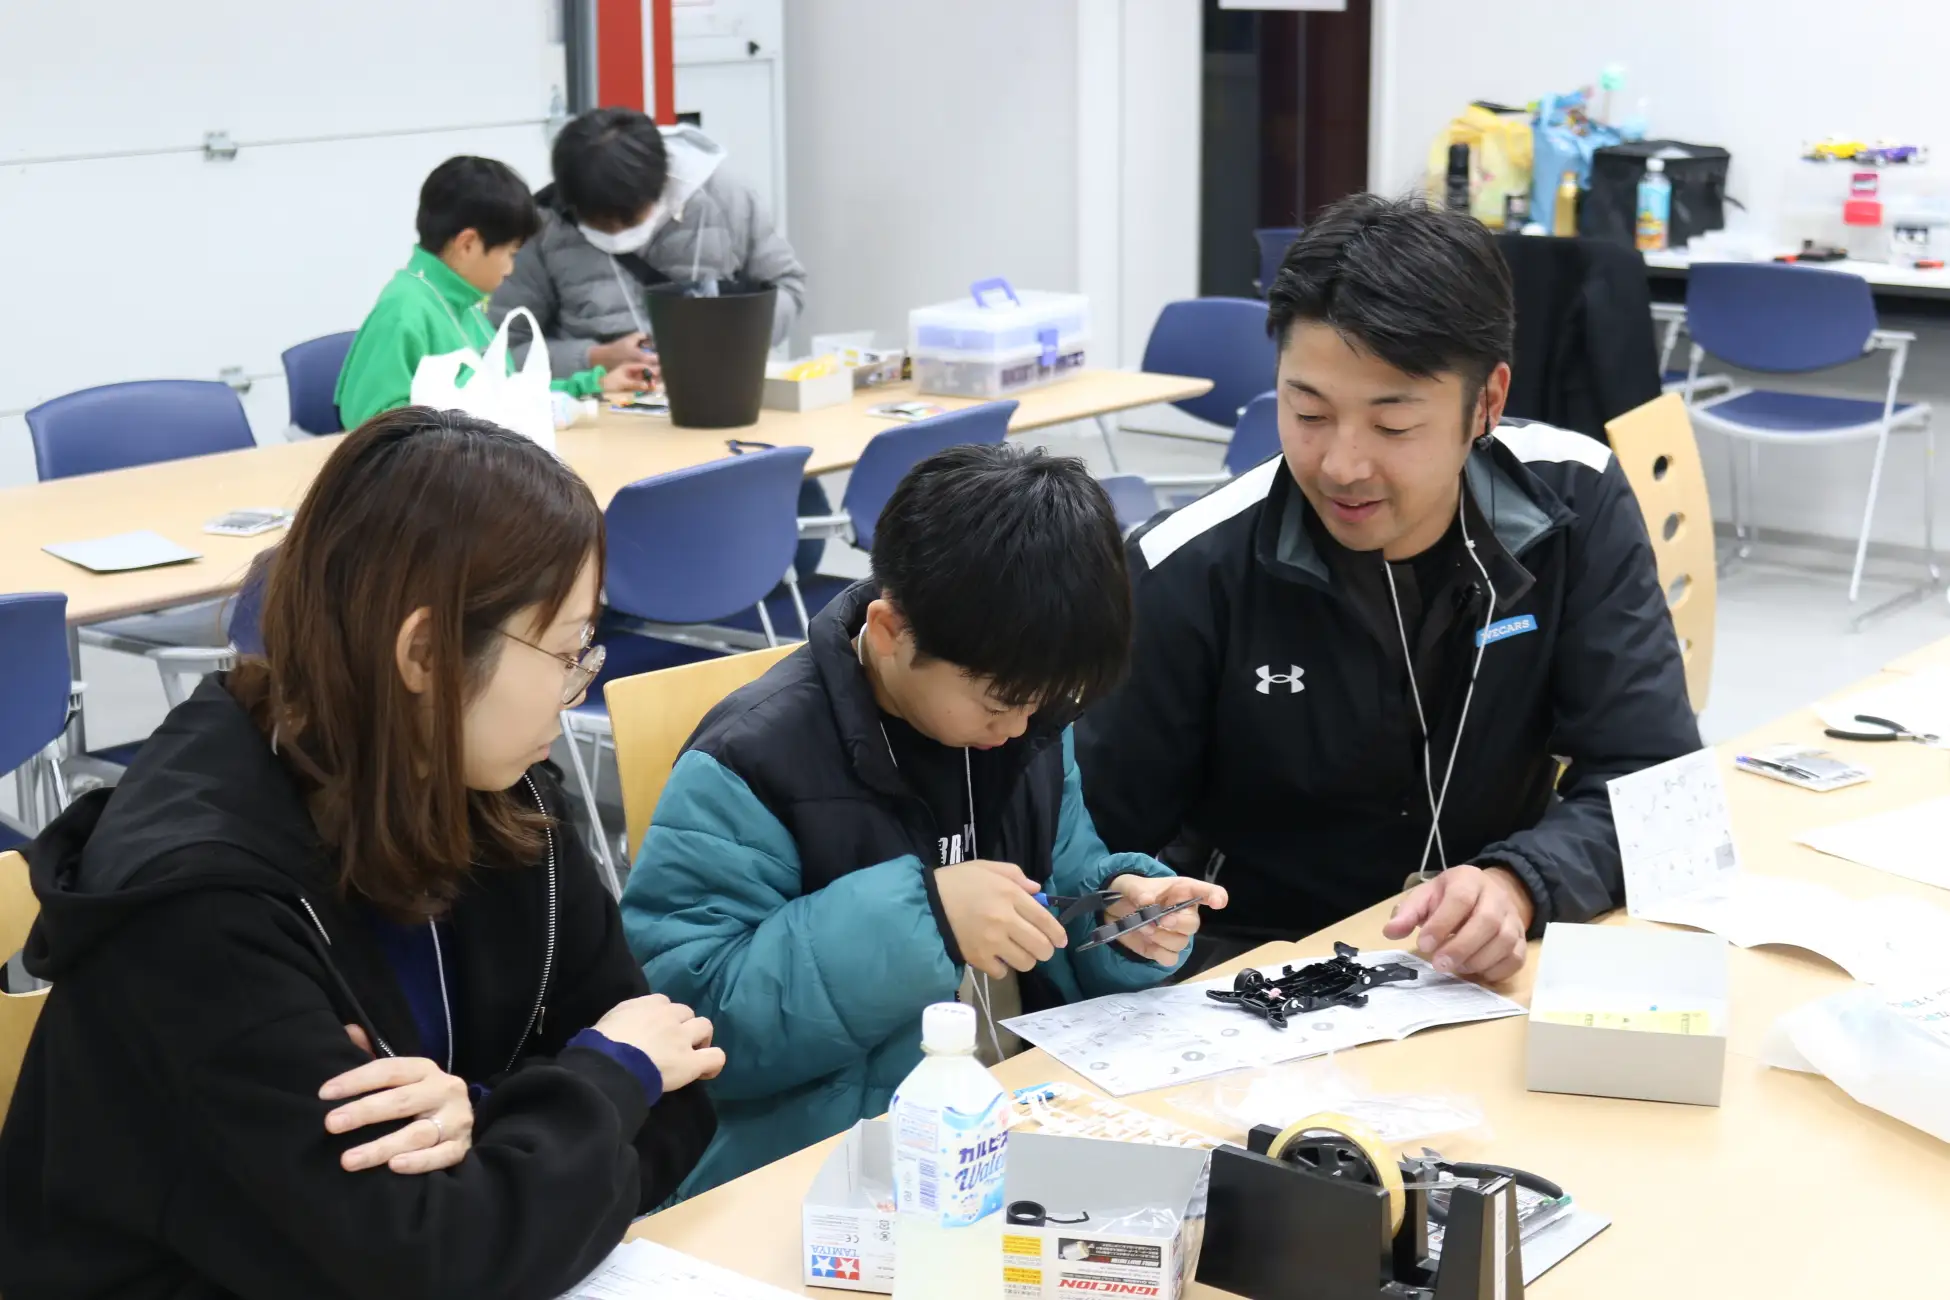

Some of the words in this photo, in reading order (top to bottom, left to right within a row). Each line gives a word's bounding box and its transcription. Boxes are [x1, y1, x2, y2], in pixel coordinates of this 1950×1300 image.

[954, 1152, 1004, 1192] Wate
[809, 1245, 860, 1258] TAMIYA
[1058, 1279, 1160, 1297] IGNICION
